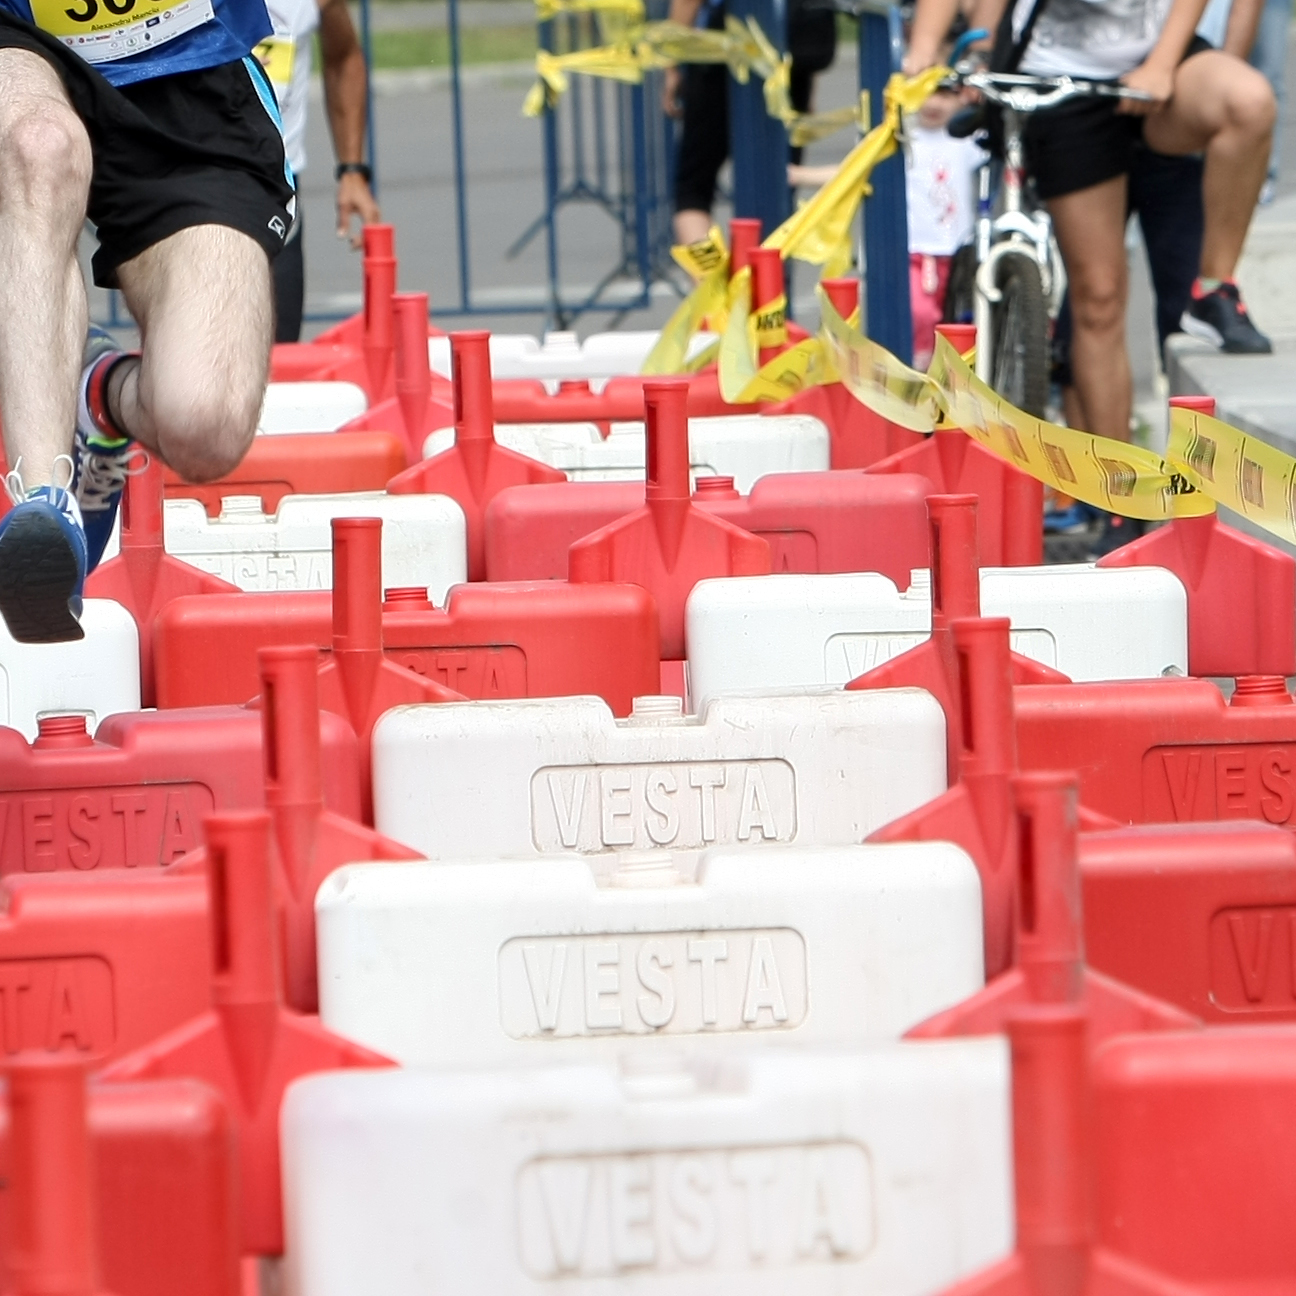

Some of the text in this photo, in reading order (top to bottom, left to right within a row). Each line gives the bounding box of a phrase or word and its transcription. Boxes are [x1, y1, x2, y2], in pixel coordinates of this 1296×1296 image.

[546, 764, 780, 848] VESTA
[520, 937, 790, 1032] VESTA
[534, 1153, 856, 1274] VESTA
